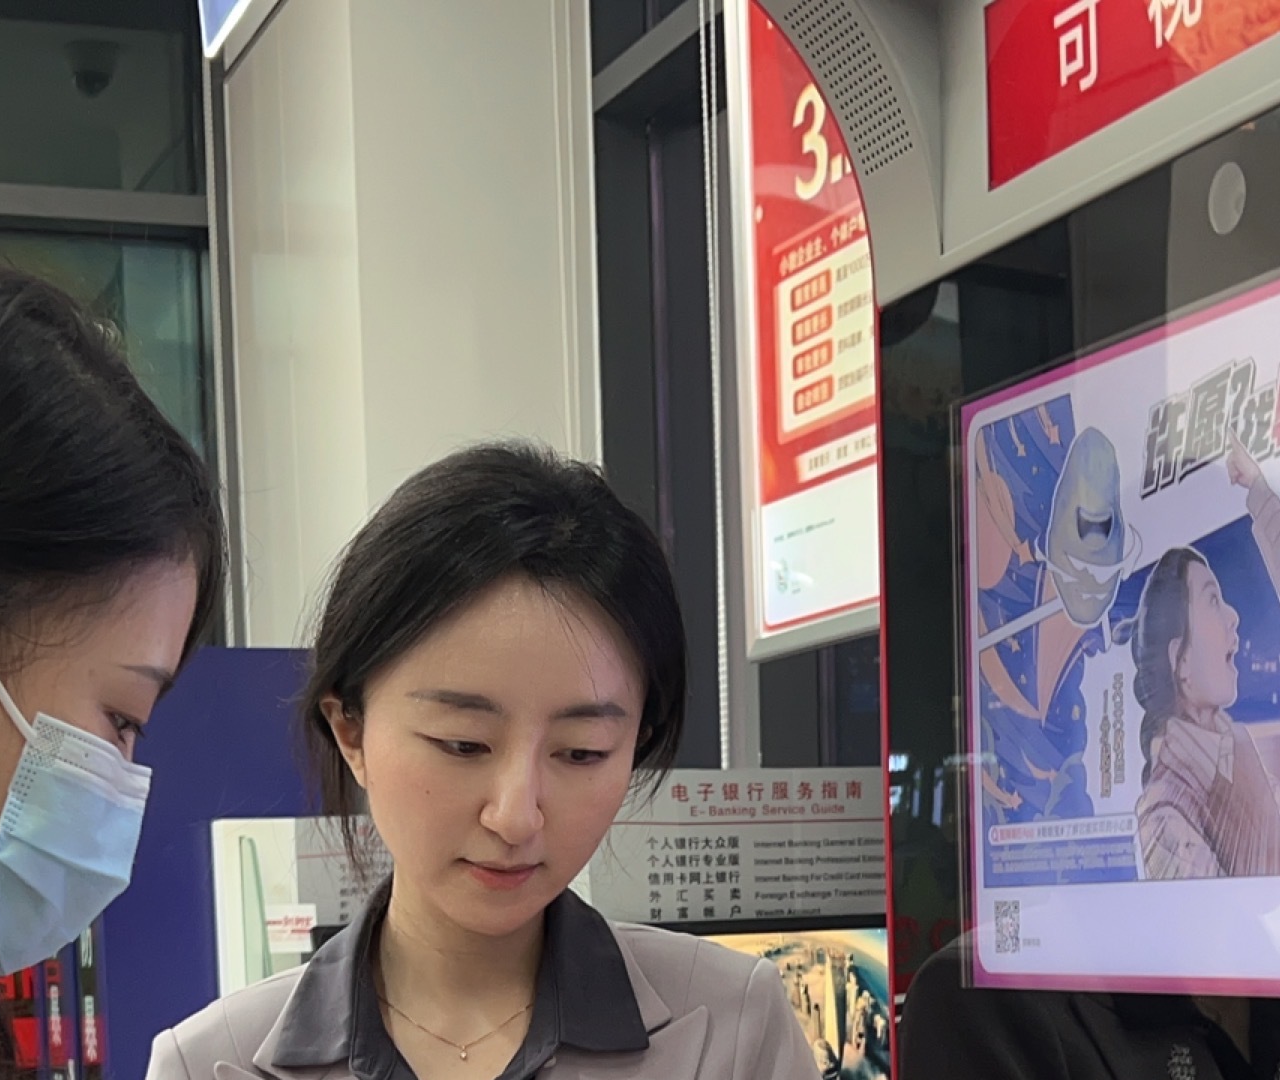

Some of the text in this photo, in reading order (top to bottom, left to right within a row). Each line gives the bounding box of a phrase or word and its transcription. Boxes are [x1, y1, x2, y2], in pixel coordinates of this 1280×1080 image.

[792, 76, 852, 200] 3.
[671, 781, 863, 802] 电子银行服务指南
[762, 804, 806, 816] Service
[811, 803, 846, 815] Guide
[646, 836, 740, 850] 个人银行大众版
[647, 854, 740, 867] 个人银行专业版
[648, 871, 740, 885] 信用卡网上银行
[650, 888, 742, 902] 外汇买卖
